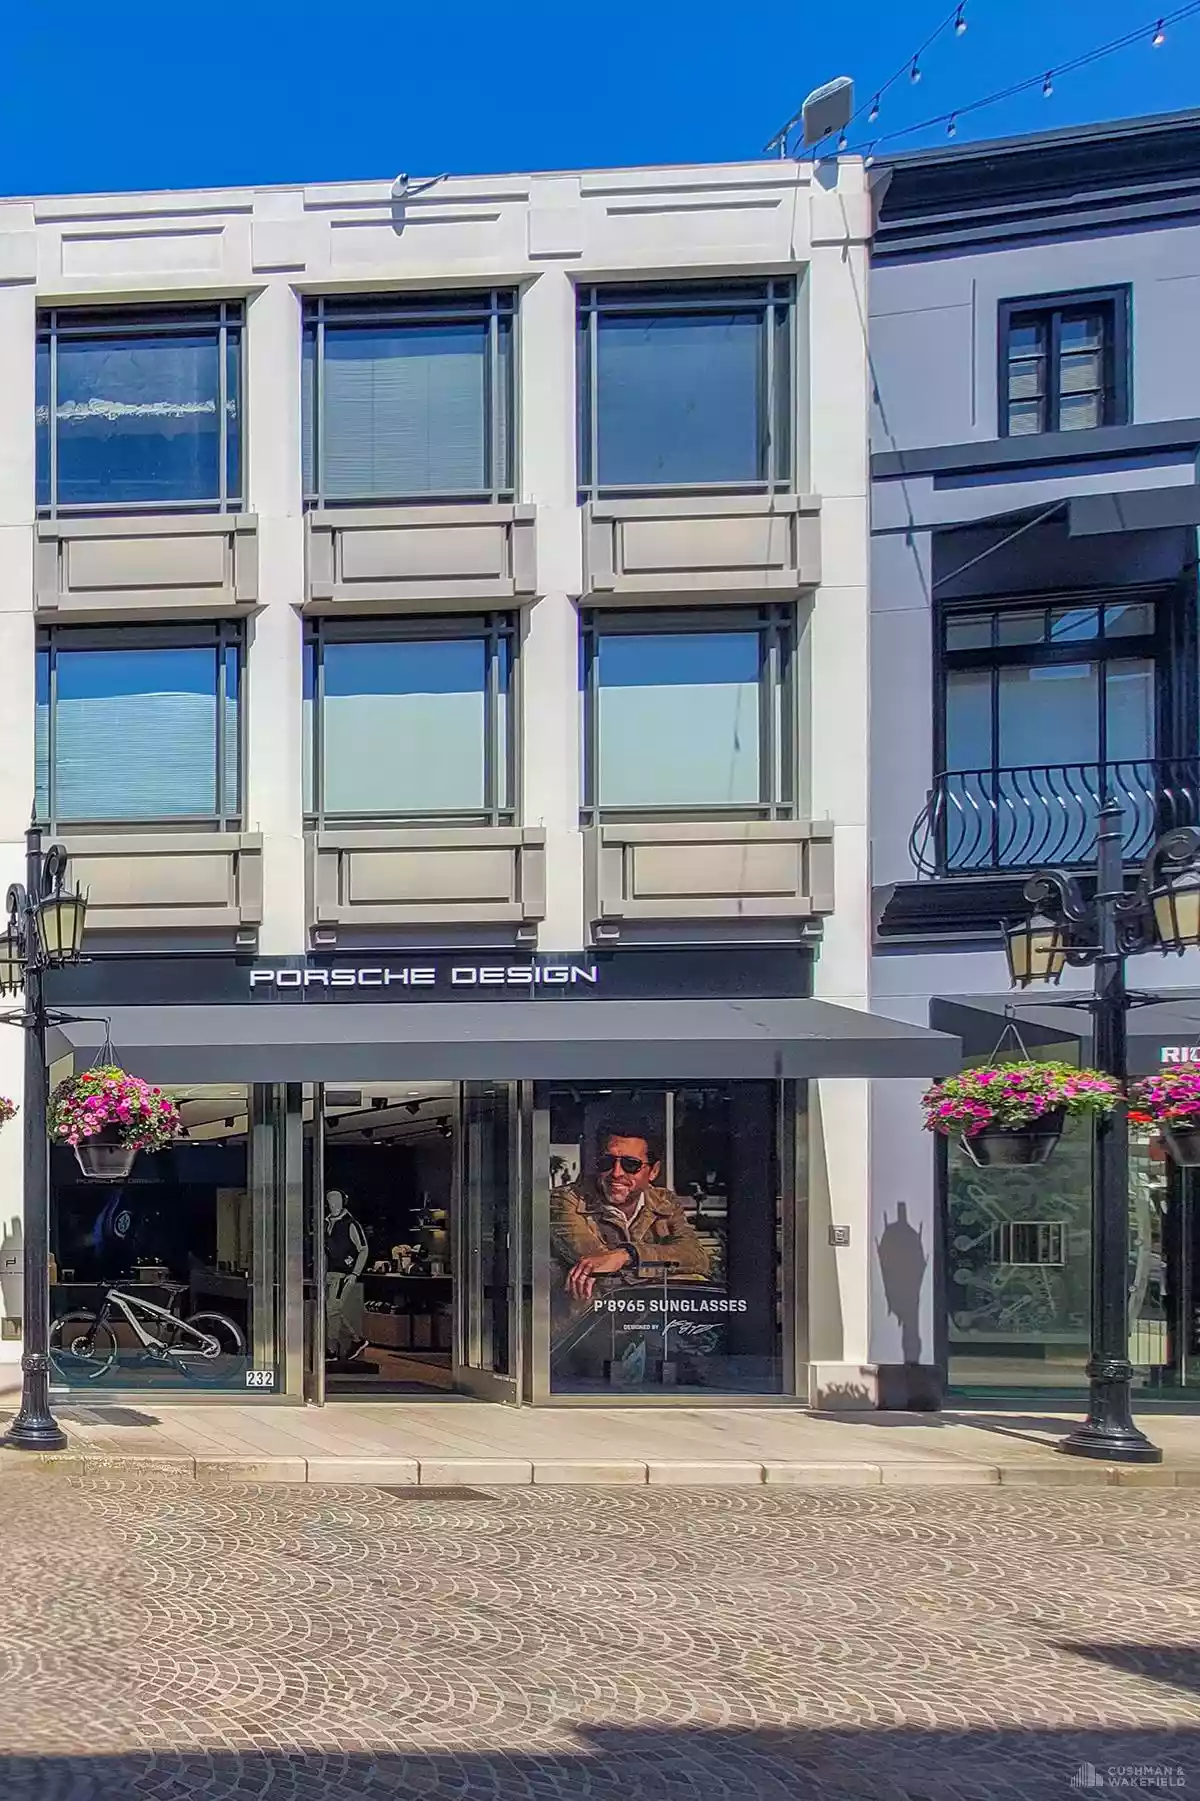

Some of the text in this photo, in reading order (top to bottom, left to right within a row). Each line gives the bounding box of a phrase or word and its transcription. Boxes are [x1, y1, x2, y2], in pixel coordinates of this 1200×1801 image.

[249, 965, 598, 986] PORSCHE DESIGN
[593, 1299, 748, 1312] P'8965 SUNGLASSES
[248, 1372, 272, 1385] 232
